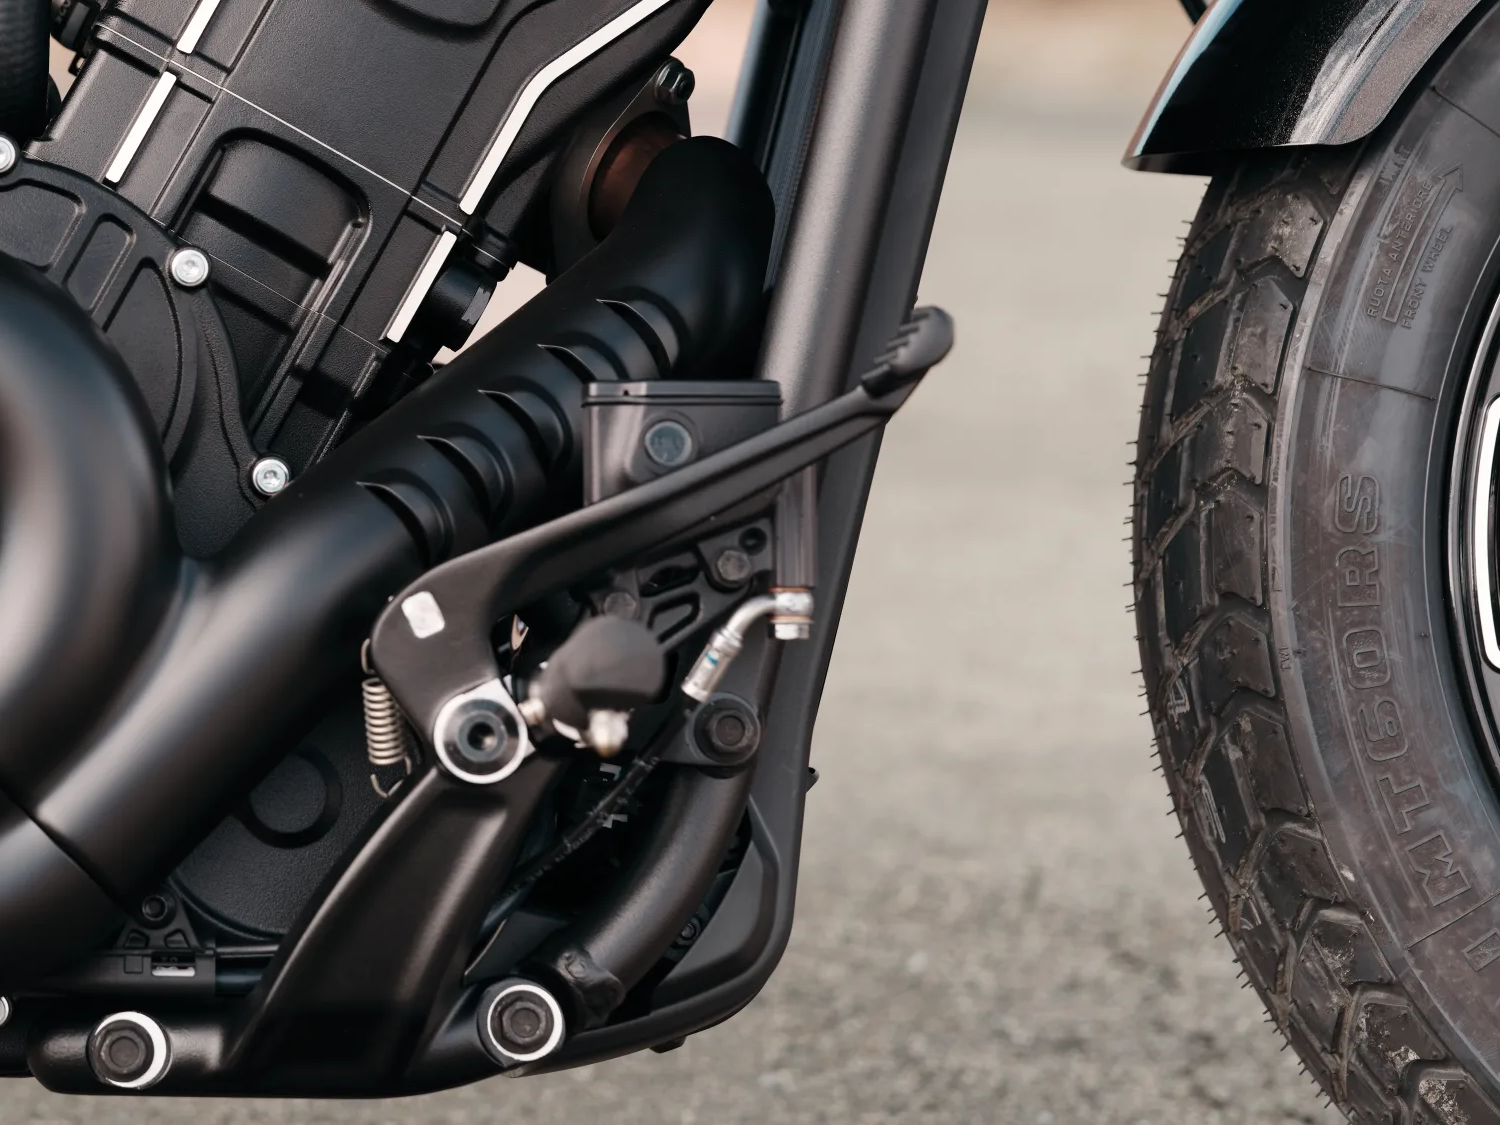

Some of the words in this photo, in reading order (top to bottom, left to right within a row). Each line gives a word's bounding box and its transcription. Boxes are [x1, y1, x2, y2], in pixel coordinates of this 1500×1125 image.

[1367, 267, 1393, 318] RUOTA
[1388, 179, 1434, 262] ANTERIORE
[1401, 280, 1428, 330] FRONT
[1421, 224, 1454, 274] WHEEL
